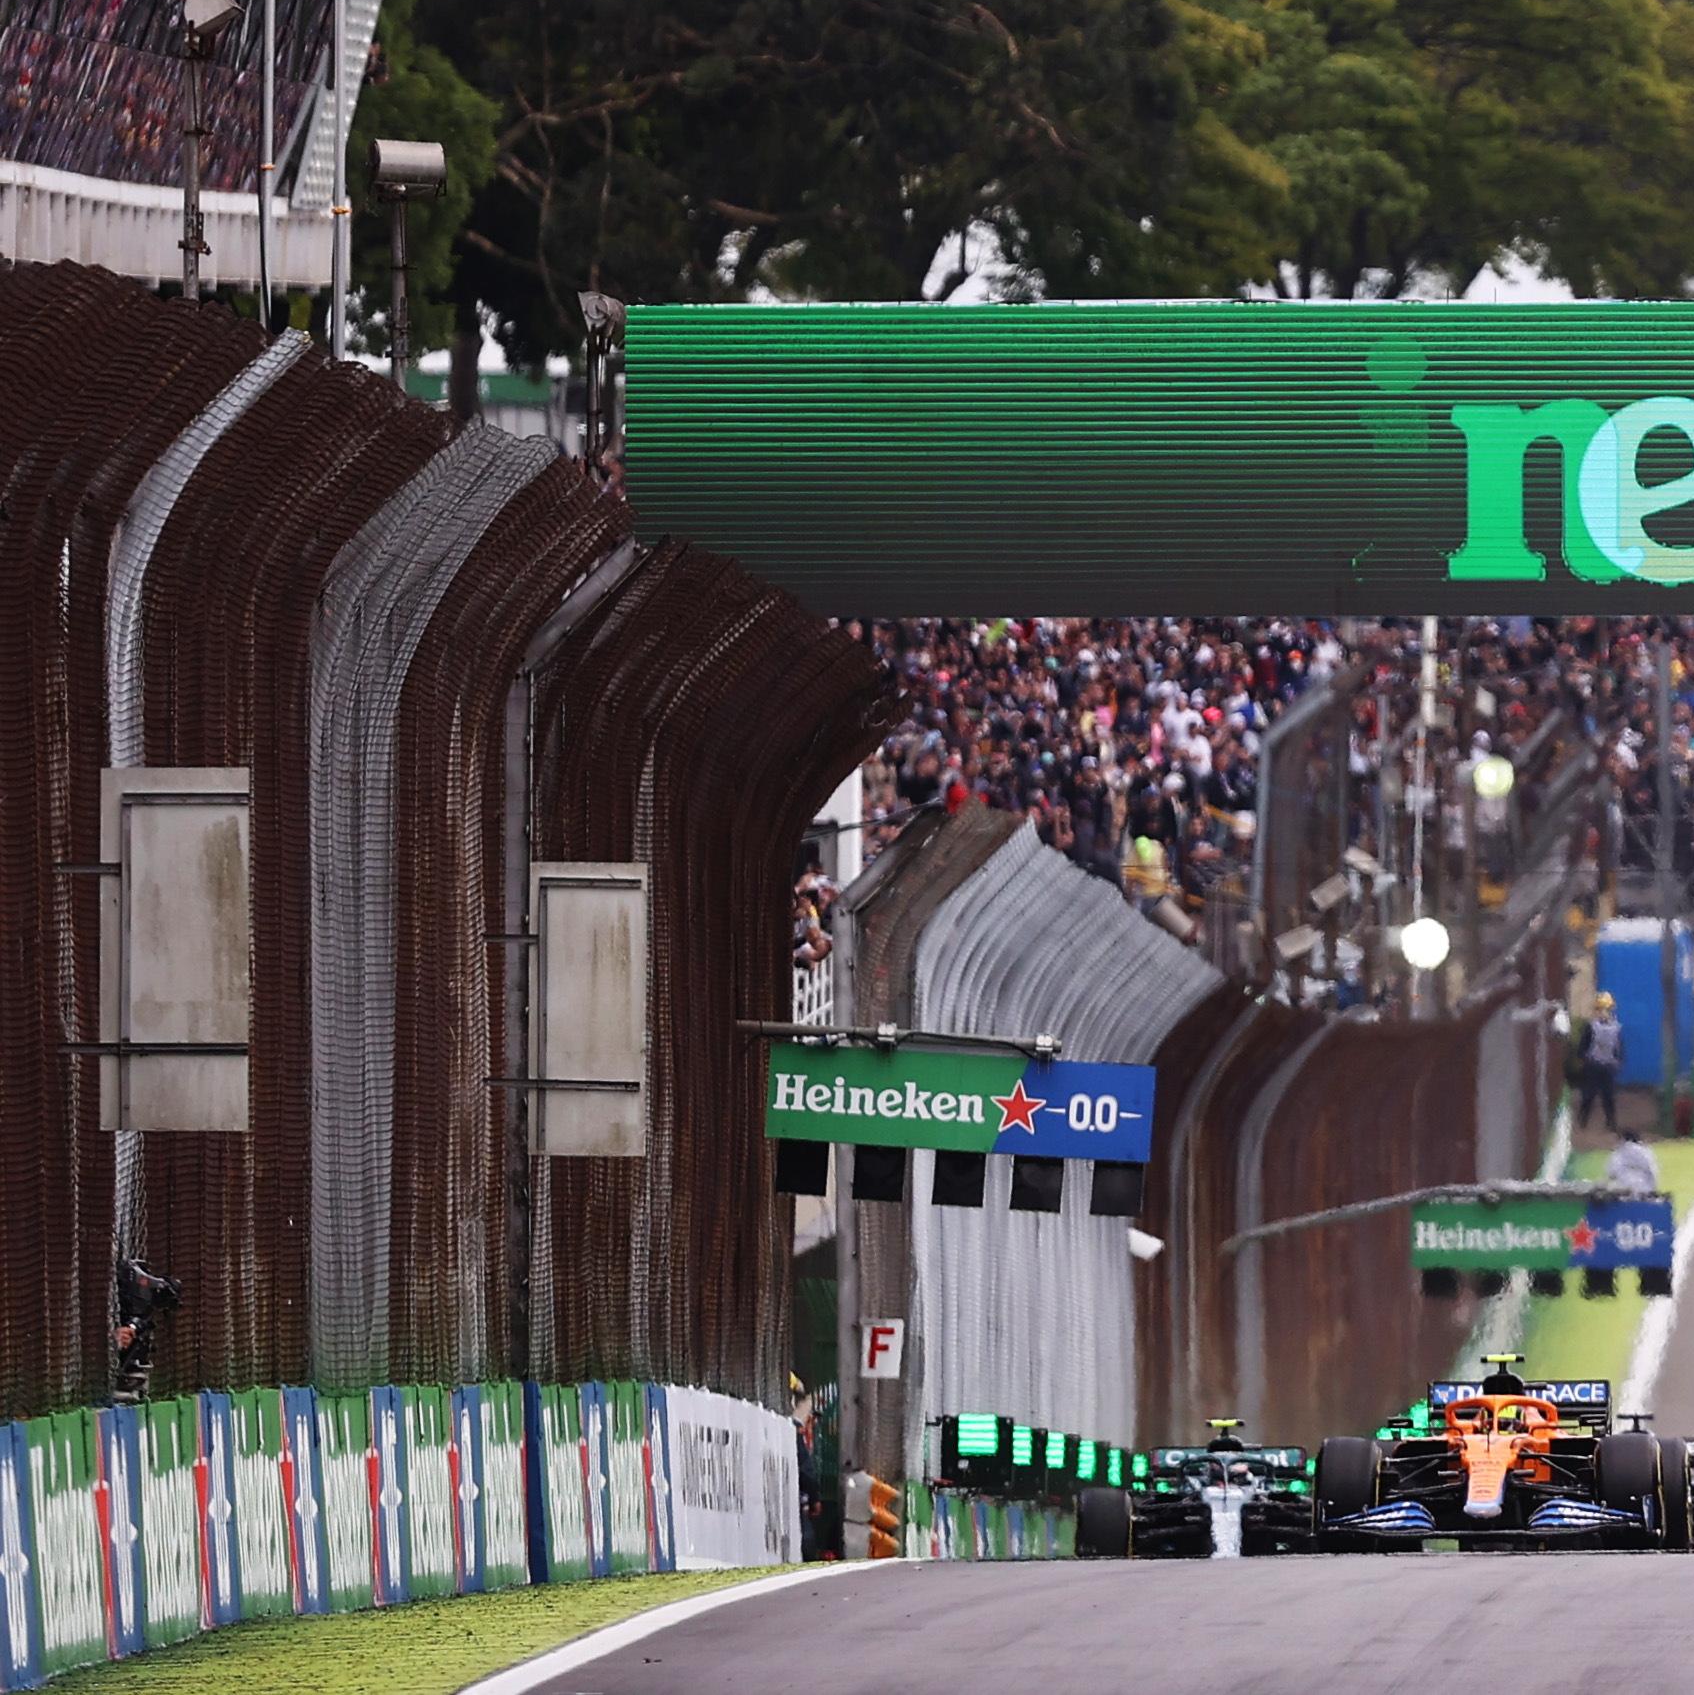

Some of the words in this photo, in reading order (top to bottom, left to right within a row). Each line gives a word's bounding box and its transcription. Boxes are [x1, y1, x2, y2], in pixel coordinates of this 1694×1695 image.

[773, 1072, 985, 1124] Heineken
[1068, 1093, 1118, 1132] 0.0
[1413, 1221, 1562, 1251] Heineken
[868, 1326, 895, 1369] F
